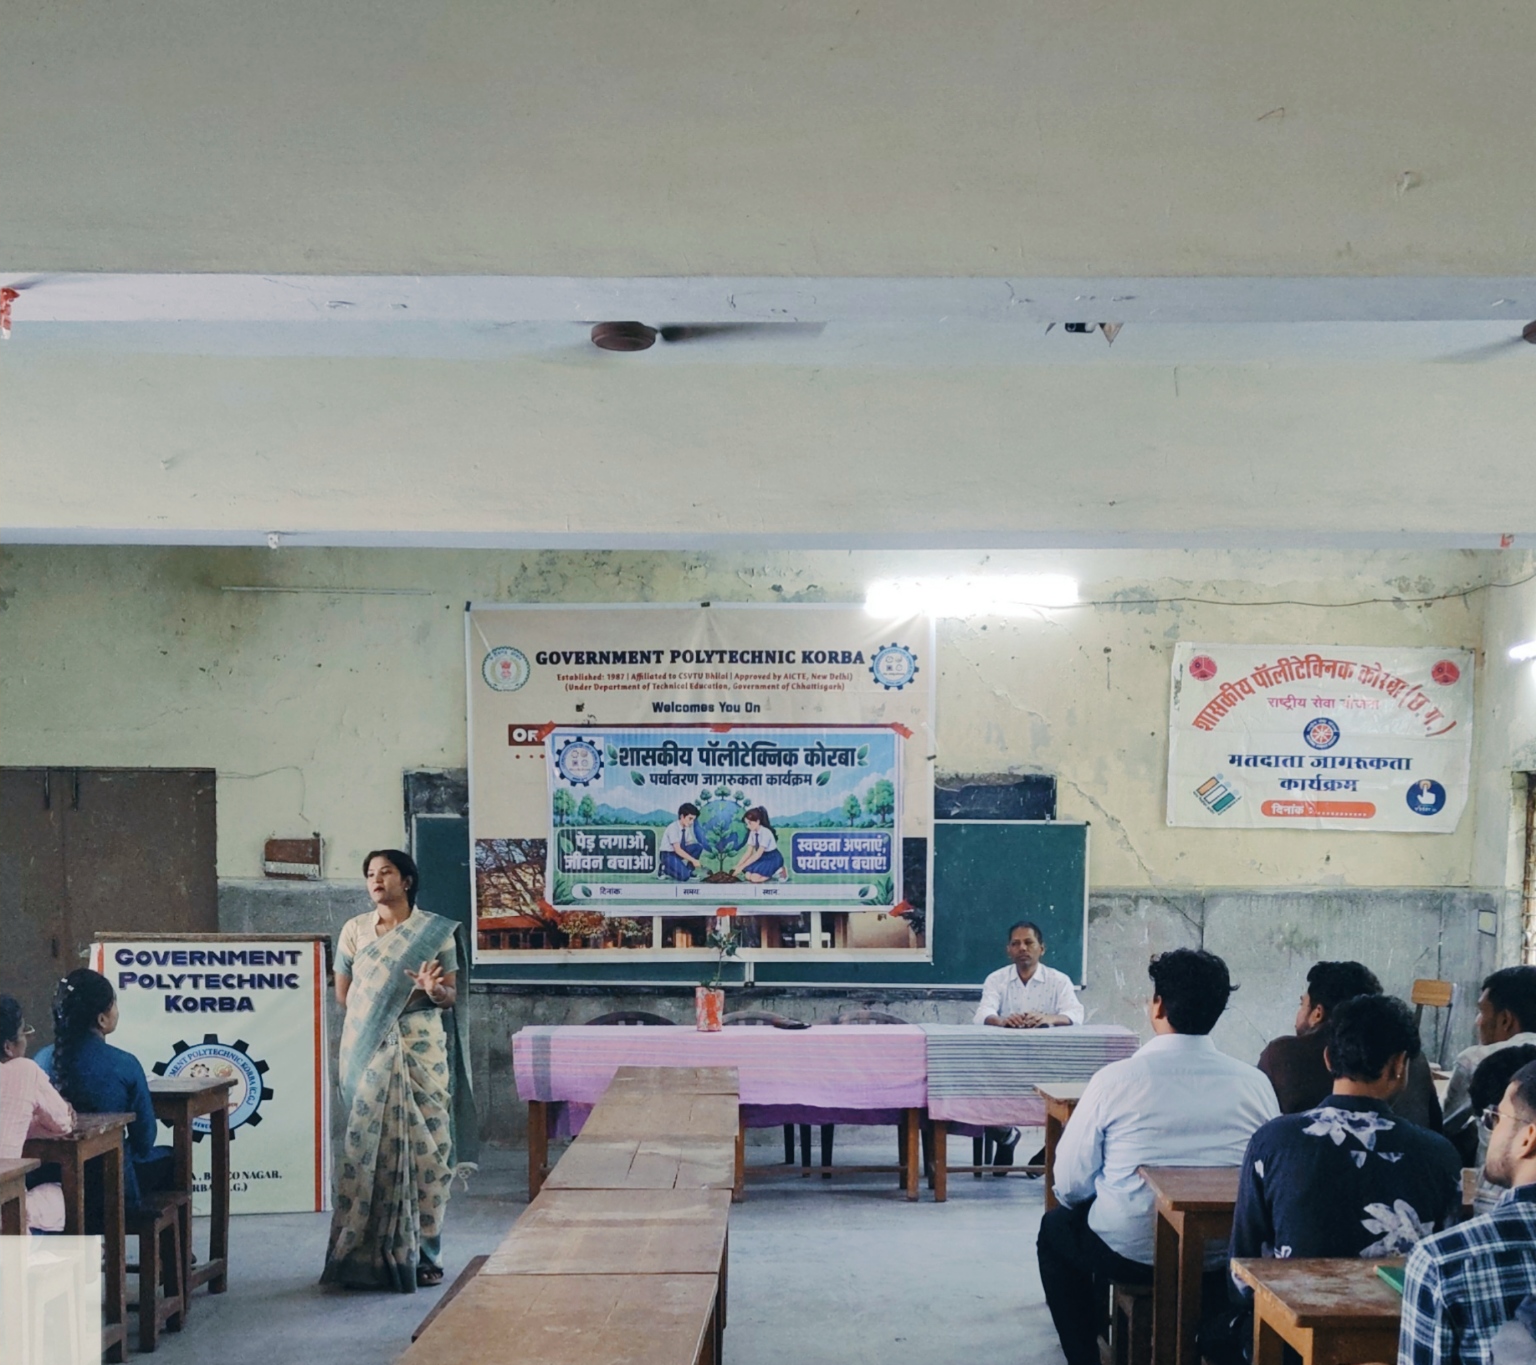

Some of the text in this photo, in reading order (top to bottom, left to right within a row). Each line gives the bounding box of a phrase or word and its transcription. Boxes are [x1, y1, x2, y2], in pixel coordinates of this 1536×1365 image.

[535, 650, 664, 665] GOVERNMENT
[669, 649, 796, 664] POLYTECHNIC
[801, 649, 865, 664] KORBA
[556, 673, 605, 681] Established:
[631, 672, 667, 682] Affiliated
[678, 672, 704, 680] CSVTU
[705, 672, 729, 680] Bhilai
[734, 672, 771, 682] Approved
[772, 672, 782, 682] by
[783, 673, 809, 682] AICTE,
[829, 673, 853, 682] Delhi)
[564, 682, 845, 692] (Under Department of Technical Education, Government of Chhattisgarh)
[1192, 678, 1256, 731] शासकीय
[1355, 661, 1409, 698] कोरबा
[652, 701, 761, 713] Welcomes You On
[1267, 694, 1306, 711] राष्ट्रीय
[1313, 695, 1336, 709] सेवा
[618, 740, 857, 767] शासकीय पॉलीटेक्निक कोरबा
[1228, 754, 1413, 771] मतदाता जागरूकता
[649, 770, 699, 786] पर्यावरण
[766, 770, 813, 787] कार्यक्रम
[1278, 773, 1360, 792] कार्यक्रम
[575, 831, 649, 852] पेड़ लगाओ,
[797, 837, 841, 852] स्वच्छता
[563, 851, 654, 870] जीवन बचाओ!
[797, 852, 887, 870] पर्यावरण बचाएं!
[114, 948, 302, 967] GOVERNMENT
[118, 971, 300, 990] POLYTECHNIC
[164, 994, 255, 1013] KORBA
[186, 1048, 244, 1063] POLYTECHNIC
[240, 1062, 257, 1087] KORBA
